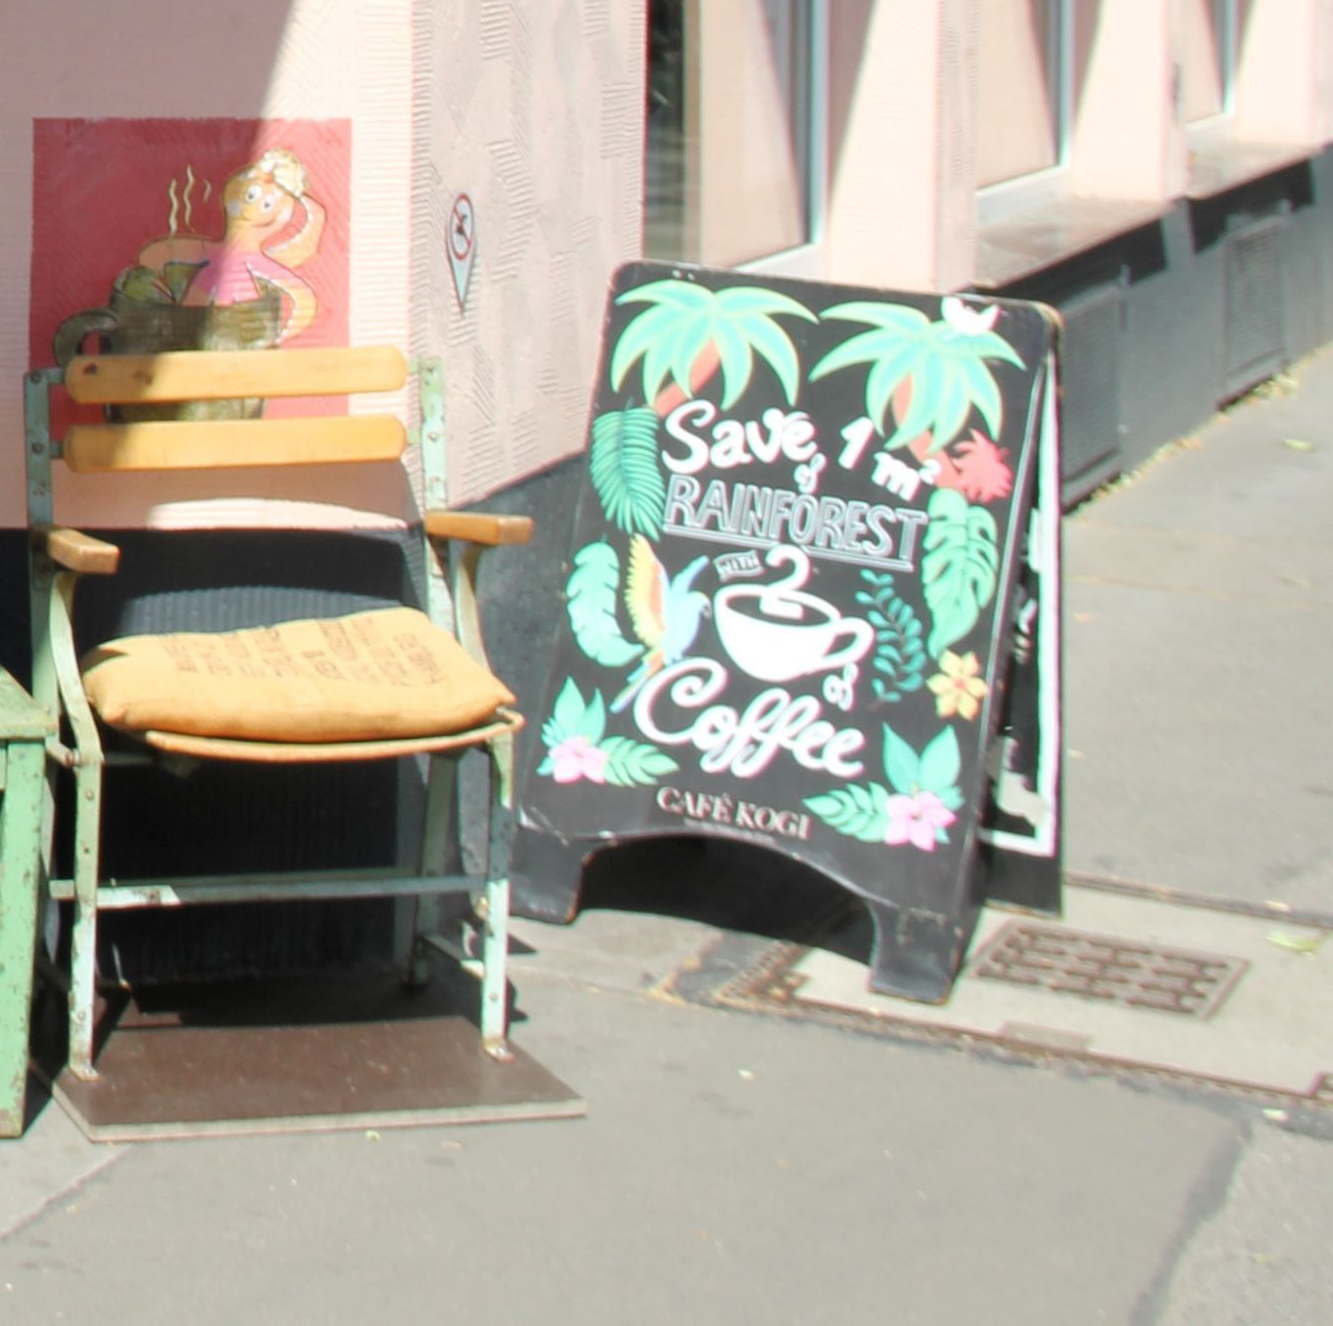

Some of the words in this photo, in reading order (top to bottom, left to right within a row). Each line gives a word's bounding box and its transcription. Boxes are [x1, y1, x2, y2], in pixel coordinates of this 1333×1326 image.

[662, 399, 818, 474] Save
[838, 416, 875, 470] 1
[664, 473, 930, 562] RAINFOREST
[633, 656, 865, 778] Coffee
[657, 787, 734, 823] CAFÉ
[736, 801, 812, 840] KOGI
